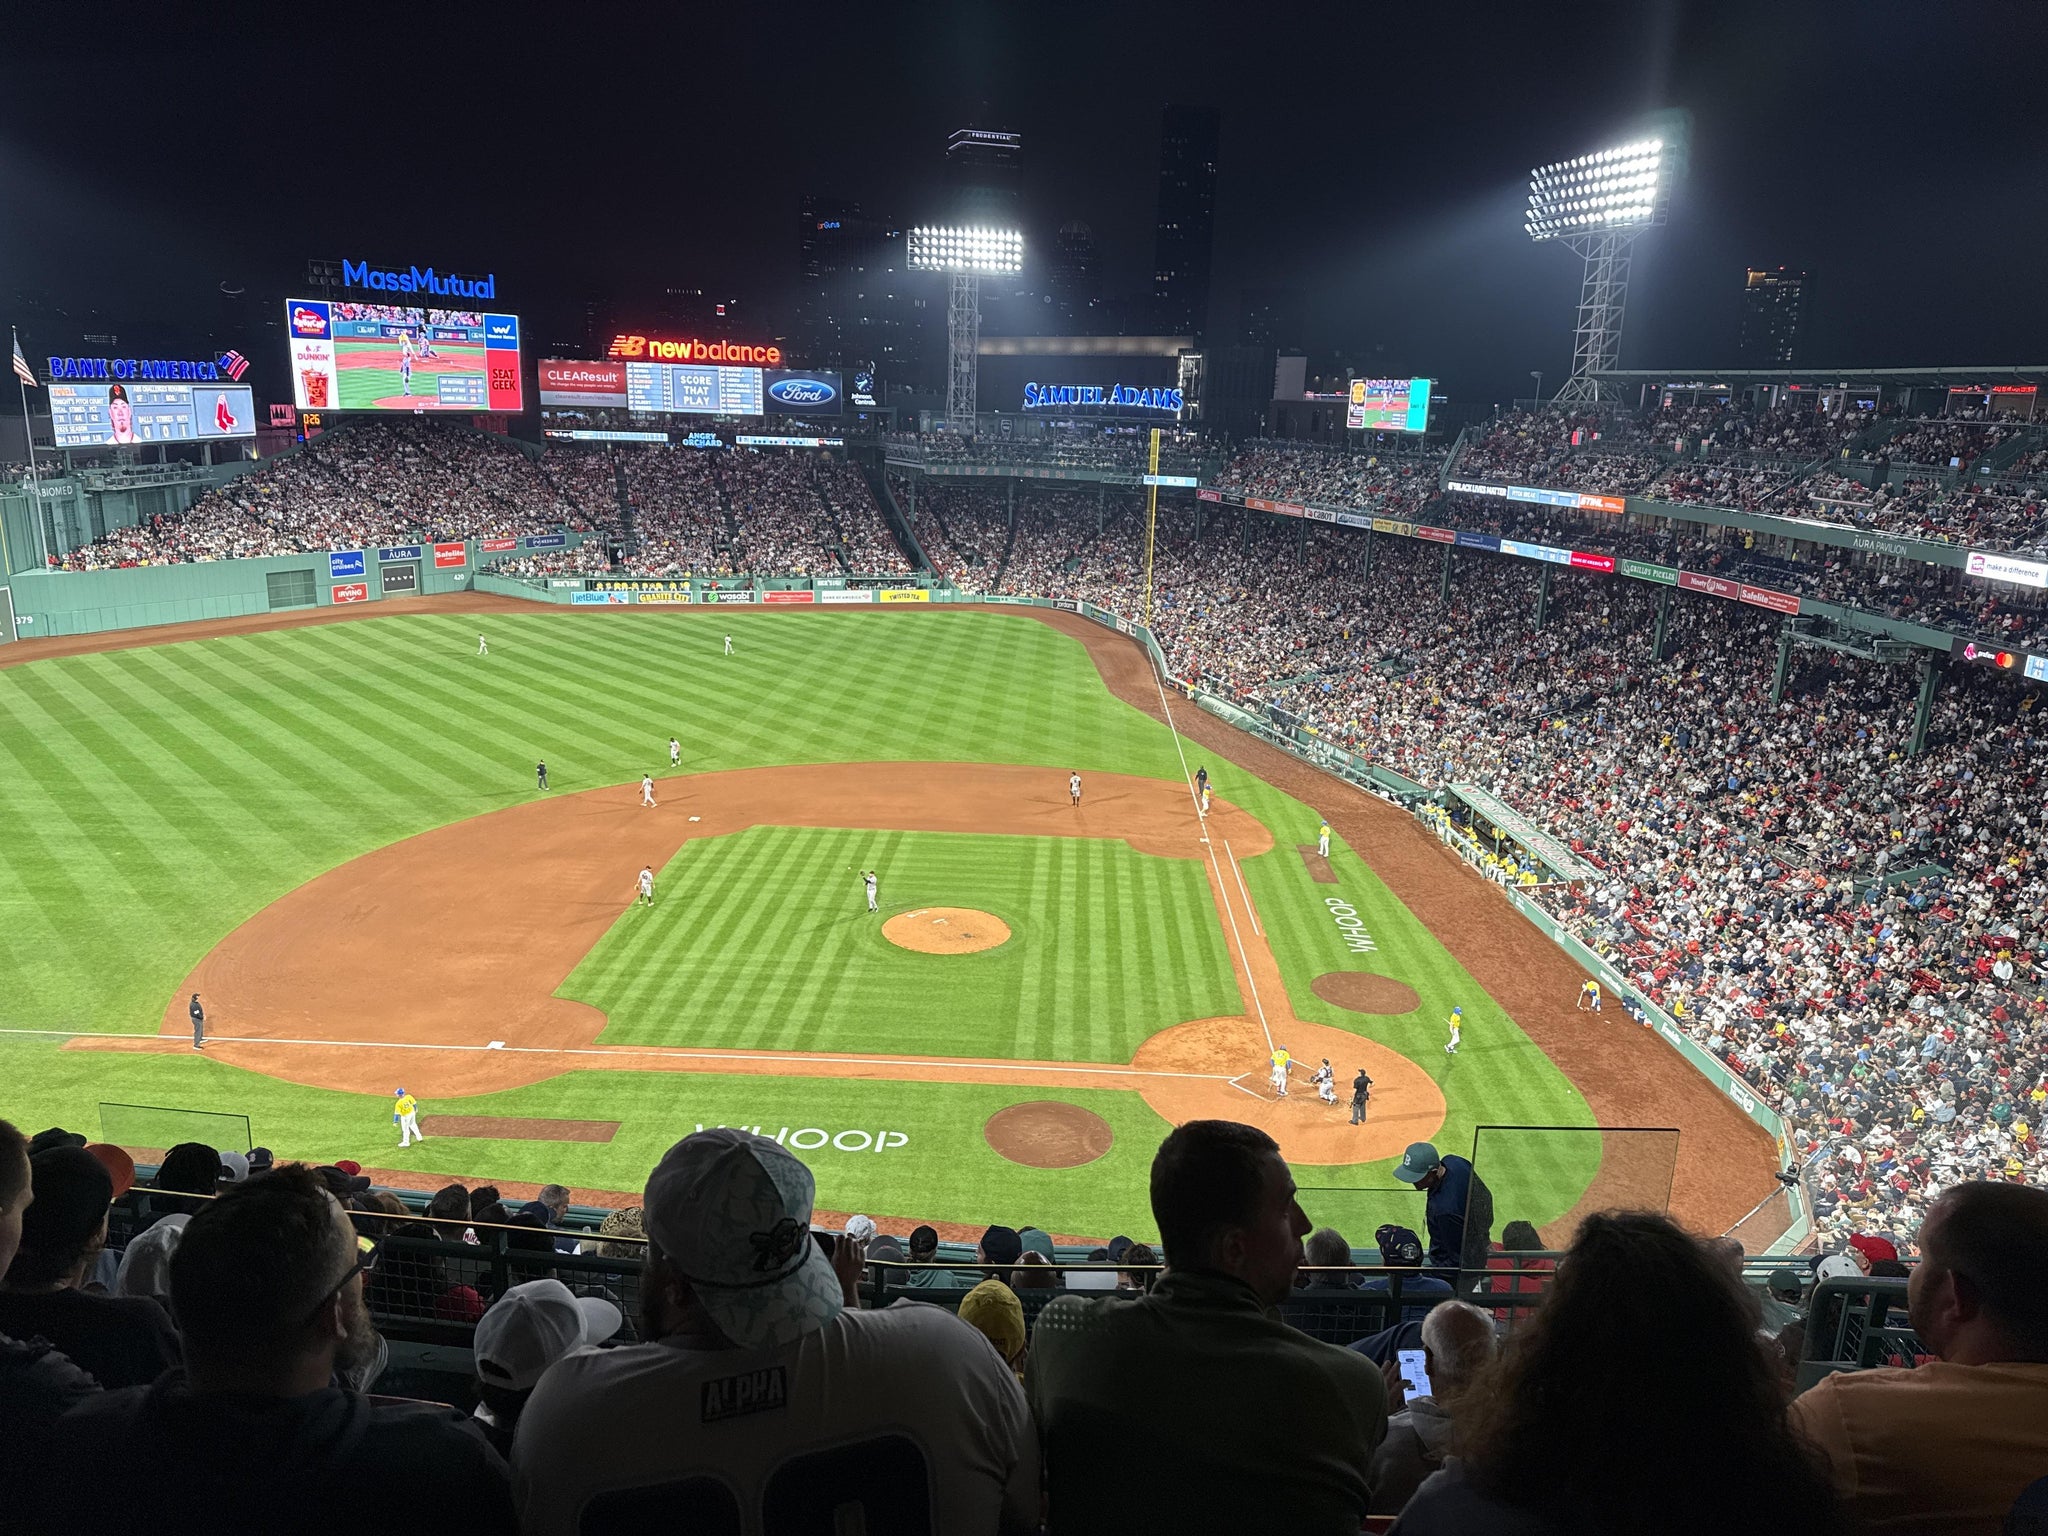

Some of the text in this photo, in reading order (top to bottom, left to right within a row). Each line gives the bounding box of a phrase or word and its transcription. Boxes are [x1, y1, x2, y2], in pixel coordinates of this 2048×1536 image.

[971, 132, 1011, 140] PRUDENTIAL
[342, 258, 495, 299] MassMutual
[649, 339, 780, 362] new balance
[48, 357, 219, 380] BANK OF AMERICA
[493, 369, 514, 379] SEAT
[547, 370, 618, 382] CLEAResult
[680, 375, 712, 385] SCORE
[492, 380, 516, 391] GEEK
[684, 386, 709, 395] THAT
[782, 383, 822, 402] Ford
[1024, 382, 1184, 412] SAMUEL ADAMS
[684, 396, 709, 406] PLAY
[303, 414, 320, 425] 0:26
[144, 425, 151, 439] 0
[162, 425, 169, 438] 0
[689, 432, 717, 440] ANGRY
[682, 439, 723, 447] ORCHARD
[37, 485, 73, 497] ABIOMED
[1472, 484, 1486, 494] LIVES
[1486, 485, 1507, 497] MATTER
[1581, 497, 1603, 507] STIHL
[496, 541, 516, 550] TICKET
[1876, 541, 1907, 555] PAVILION
[436, 550, 464, 558] Safelite
[332, 558, 344, 566] city
[332, 563, 355, 571] cruises
[1652, 570, 1675, 581] PICKLES
[1986, 563, 2002, 572] make
[2008, 566, 2040, 579] difference
[1690, 577, 1727, 592] Ninety Nine
[338, 589, 363, 597] IRVING
[575, 592, 604, 602] jetBlue
[640, 592, 690, 601] GRANITE CITY
[719, 591, 749, 600] wasabi
[889, 593, 910, 601] TWISTED
[1742, 589, 1768, 604] Safelite
[15, 616, 33, 624] 379
[1325, 897, 1378, 952] WHOOP
[695, 1123, 909, 1152] HOOP
[1403, 1154, 1411, 1166] B
[704, 1368, 785, 1416] ALPHA
